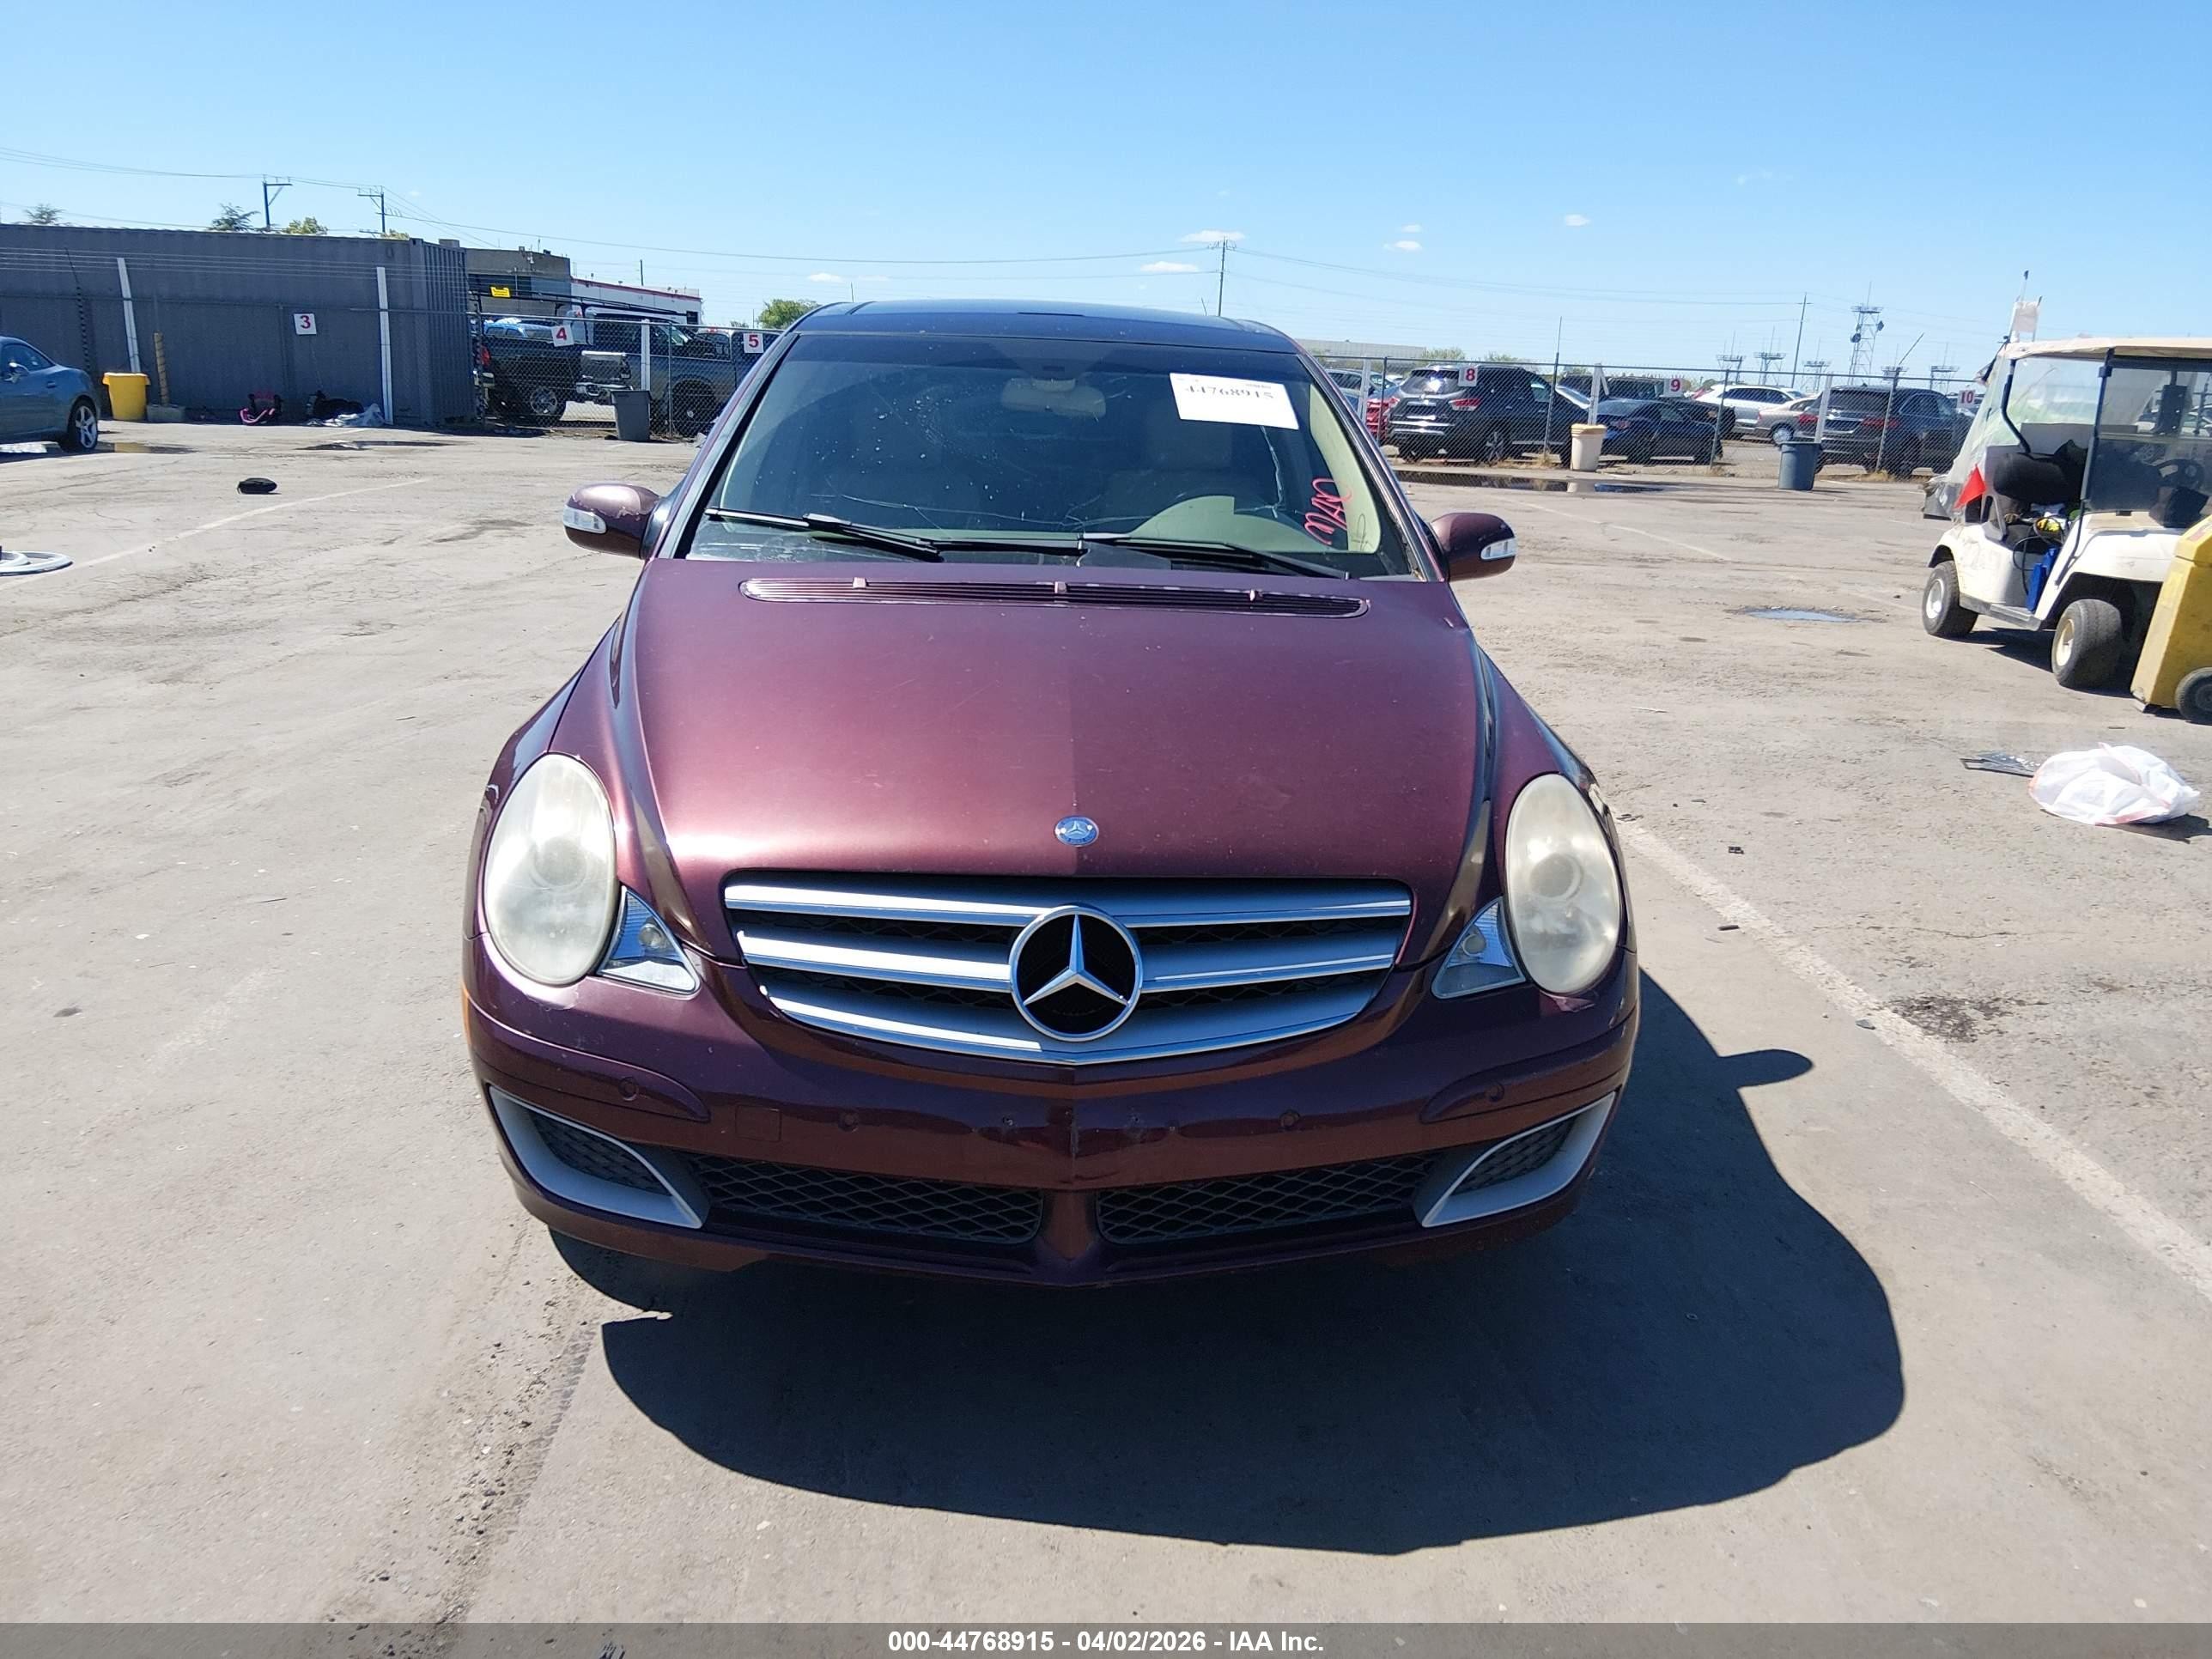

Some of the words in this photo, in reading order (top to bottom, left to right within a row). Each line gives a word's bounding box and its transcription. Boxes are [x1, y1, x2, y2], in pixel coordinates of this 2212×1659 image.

[301, 315, 311, 329] 3
[556, 327, 567, 341] 4
[749, 334, 759, 348] 5
[1466, 368, 1475, 381] 8
[1670, 379, 1680, 392] 9
[1961, 391, 1974, 404] 10
